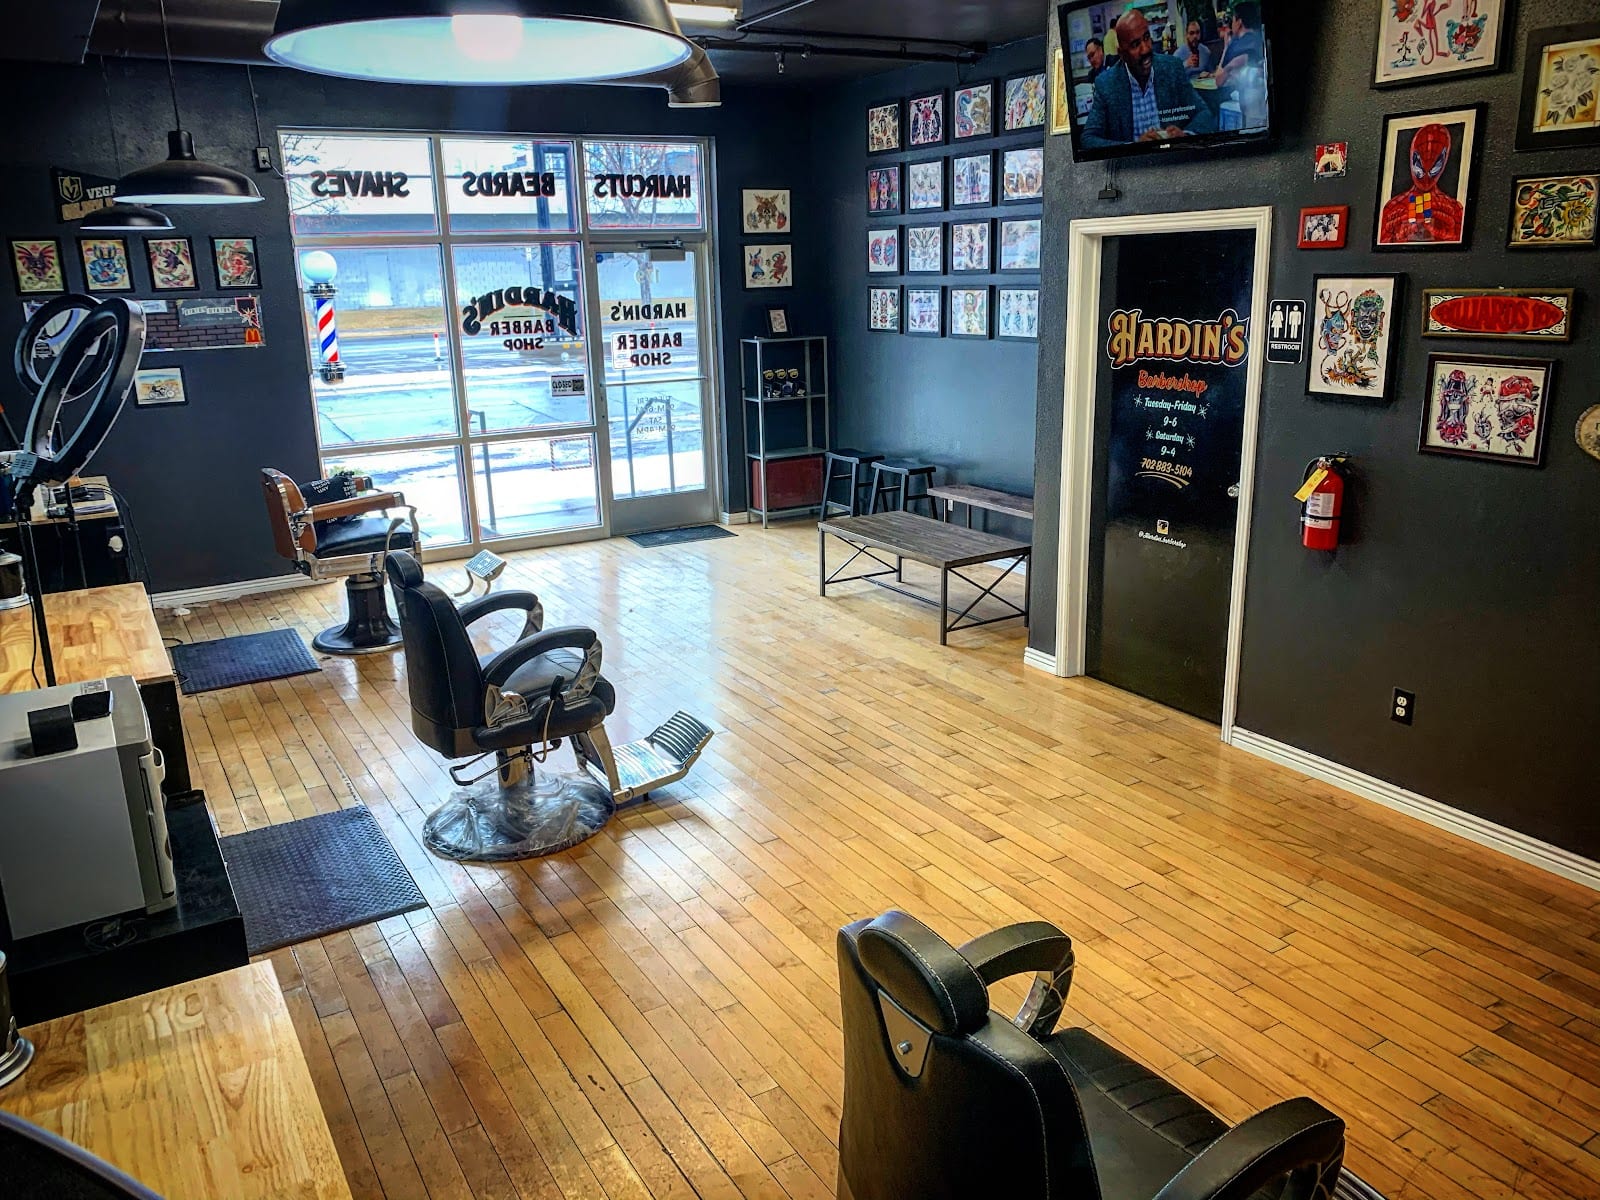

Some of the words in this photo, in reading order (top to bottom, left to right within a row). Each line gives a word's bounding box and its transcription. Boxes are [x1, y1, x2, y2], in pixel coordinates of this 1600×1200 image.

[86, 185, 117, 200] VEGA
[1108, 310, 1248, 367] HARDIN'S
[1270, 343, 1300, 351] RESTROOM
[1138, 370, 1207, 398] Barbershop
[1144, 397, 1197, 413] Tuesday-Friday
[1163, 416, 1178, 427] 9-6
[1155, 430, 1185, 444] Saturday
[1160, 446, 1176, 457] 9-4
